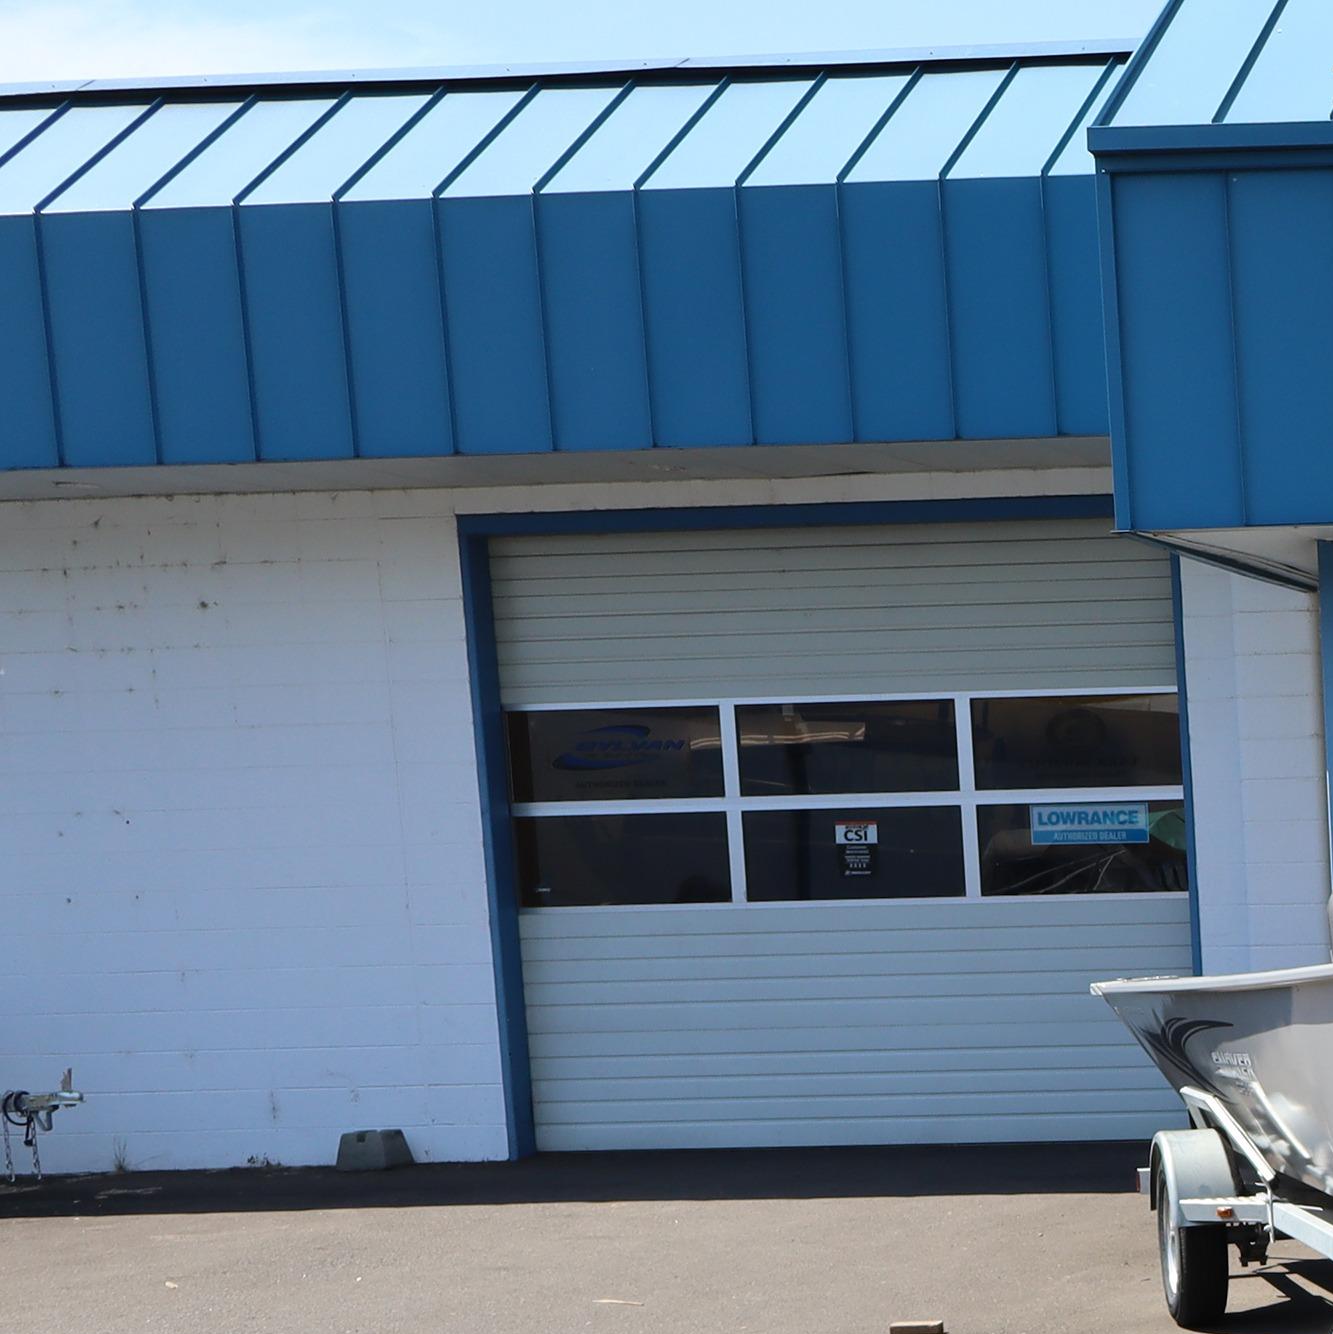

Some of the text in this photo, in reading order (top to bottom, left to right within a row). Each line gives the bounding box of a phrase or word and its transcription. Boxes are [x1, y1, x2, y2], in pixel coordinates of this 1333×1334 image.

[1037, 809, 1139, 826] LOWRANCE
[1053, 830, 1127, 841] AUTHORIZED DEALER
